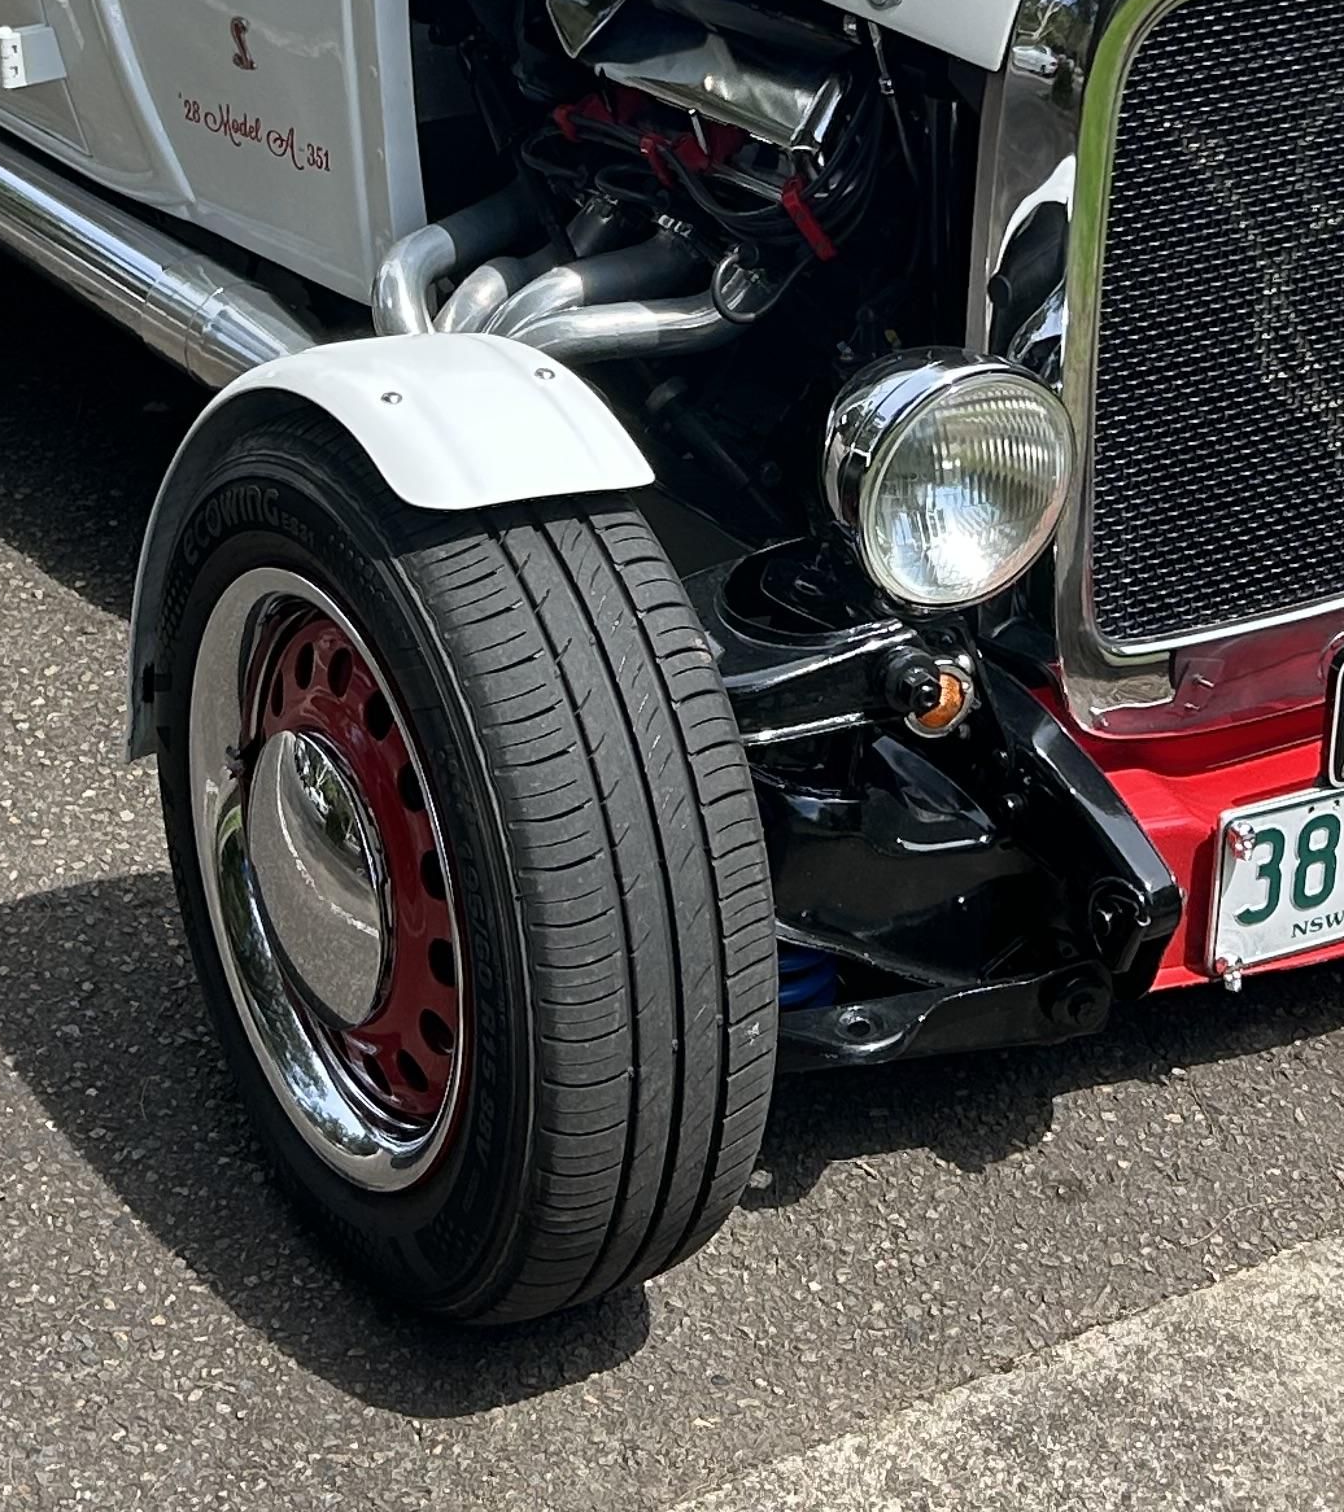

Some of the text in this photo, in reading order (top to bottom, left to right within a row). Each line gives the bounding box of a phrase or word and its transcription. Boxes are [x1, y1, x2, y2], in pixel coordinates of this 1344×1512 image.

[204, 104, 263, 148] Model
[267, 127, 305, 171] A
[307, 143, 331, 172] 351
